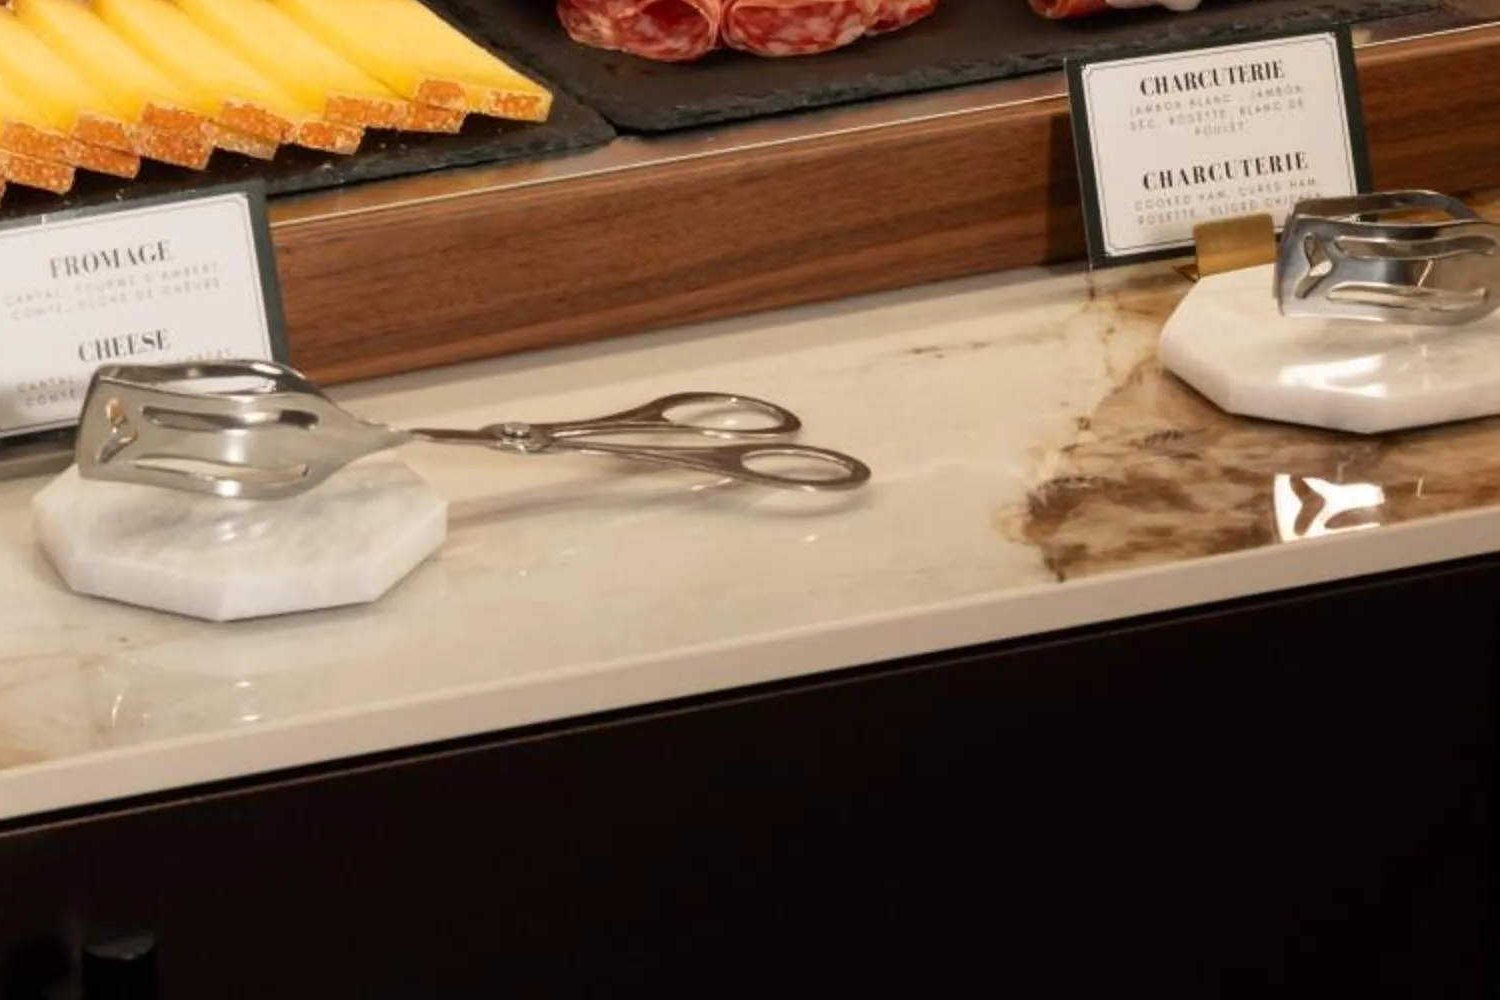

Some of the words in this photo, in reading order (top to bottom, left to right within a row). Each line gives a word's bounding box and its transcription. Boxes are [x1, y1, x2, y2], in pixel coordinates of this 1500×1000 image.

[1140, 59, 1285, 96] CHARCUTERIE
[1142, 151, 1309, 191] CHARCUTERIE
[50, 239, 171, 279] FROMAGE
[77, 327, 171, 362] CHEESE
